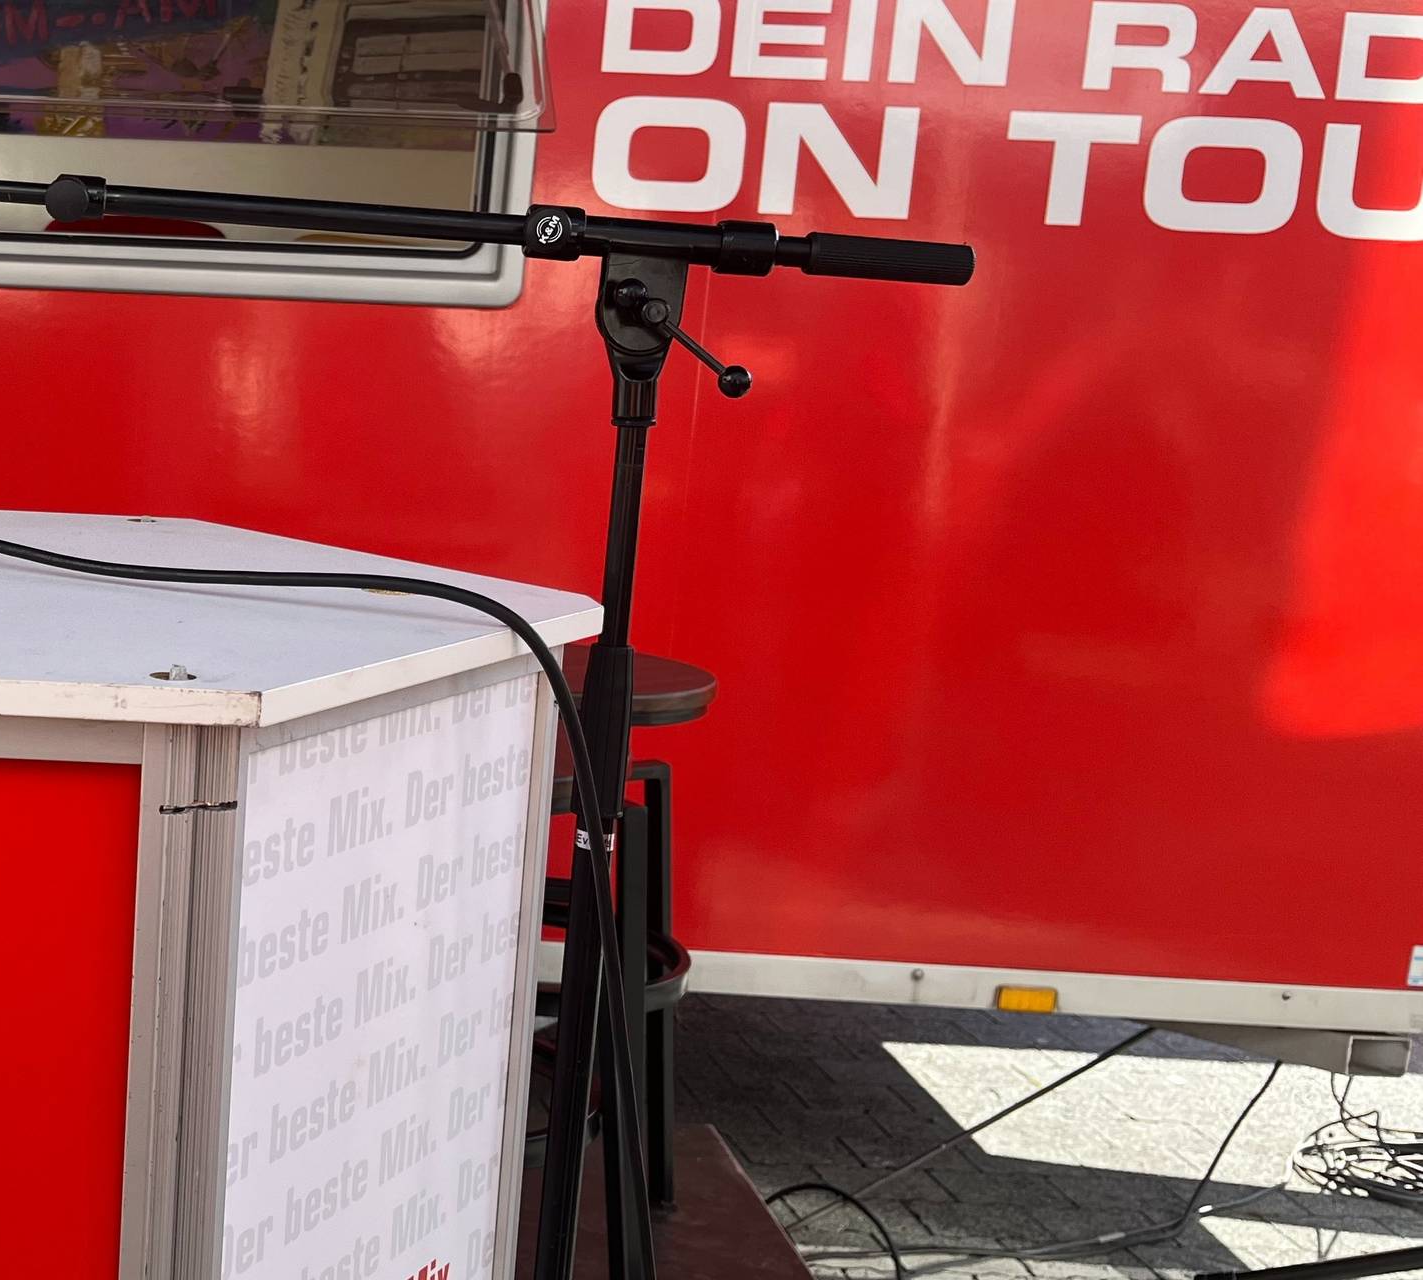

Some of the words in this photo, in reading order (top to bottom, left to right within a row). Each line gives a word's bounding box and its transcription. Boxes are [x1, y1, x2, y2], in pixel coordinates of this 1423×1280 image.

[600, 0, 1014, 88] DEIN
[1081, 2, 1423, 104] RAD
[539, 215, 560, 244] K&M
[590, 95, 921, 221] ON
[1006, 110, 1423, 242] TOU
[327, 786, 393, 858] Mix.
[404, 769, 454, 829] Der
[461, 743, 528, 808] beste
[237, 908, 329, 989] beste
[340, 873, 405, 944] Mix.
[415, 853, 464, 912] Der
[253, 995, 343, 1079] beste
[354, 957, 416, 1029] Mix.
[427, 933, 474, 992] Der
[268, 1079, 357, 1164] beste
[367, 1036, 427, 1109] Mix.
[437, 1011, 482, 1068] Der
[284, 1158, 369, 1247] beste
[378, 1113, 437, 1188] Mix.
[447, 1082, 491, 1142] Der
[390, 1188, 447, 1261] Mix.
[456, 1151, 499, 1214] Der
